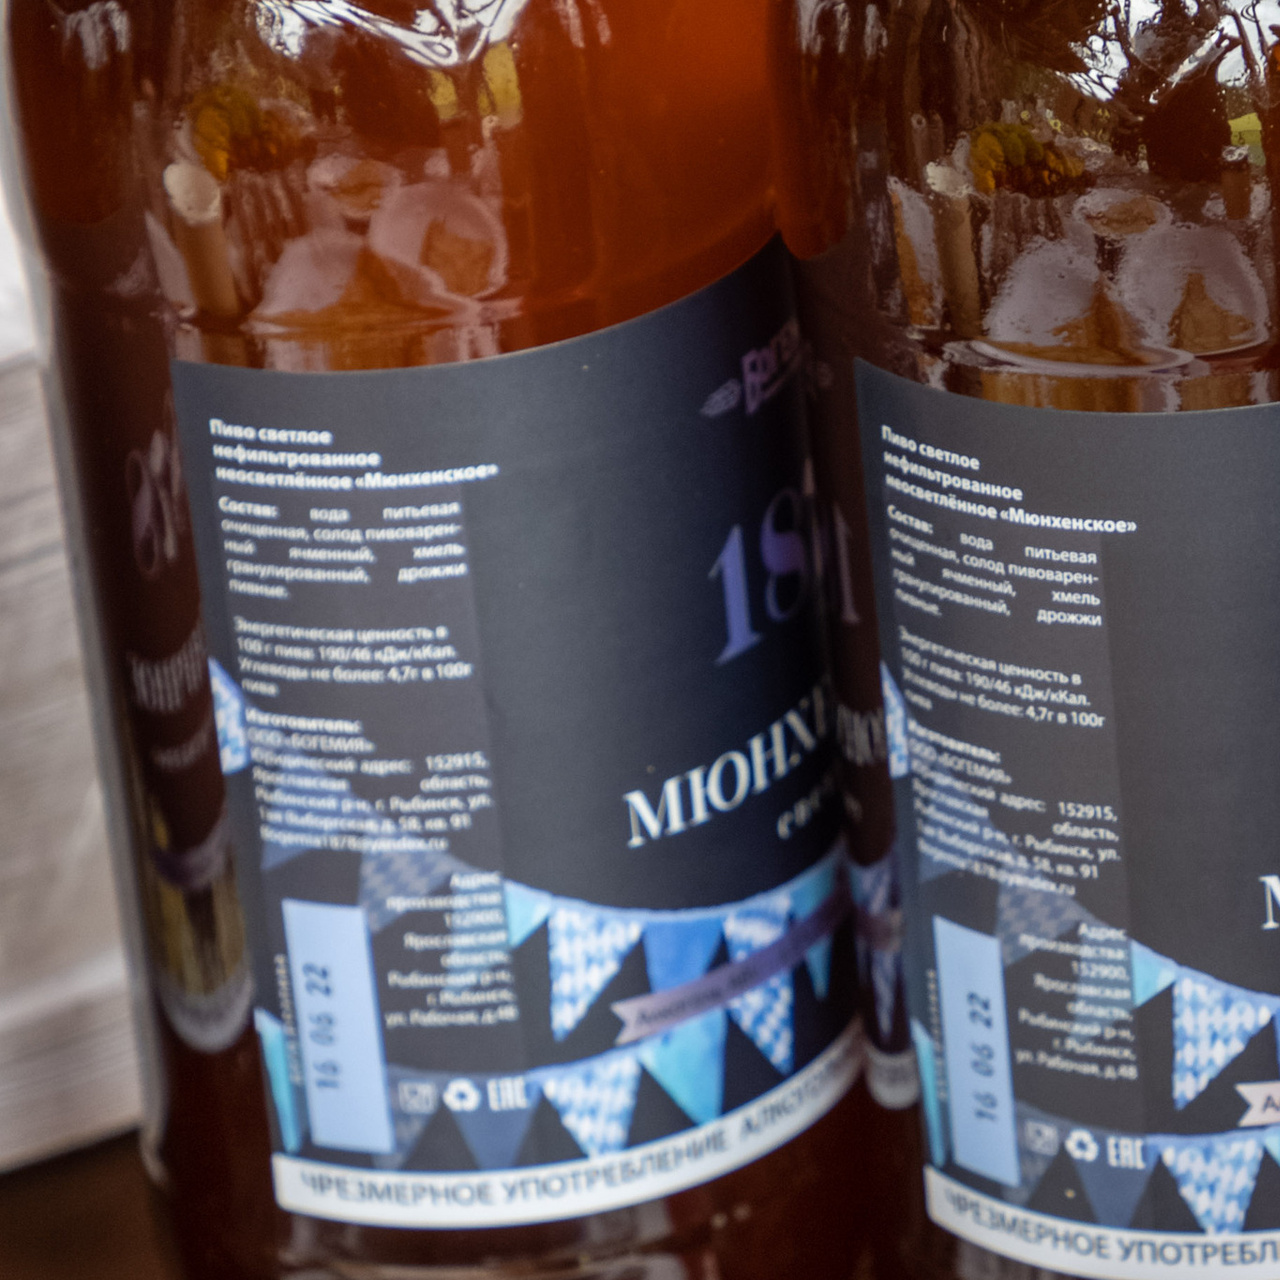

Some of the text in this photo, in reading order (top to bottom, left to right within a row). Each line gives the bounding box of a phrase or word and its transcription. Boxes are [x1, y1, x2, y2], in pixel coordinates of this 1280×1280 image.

[209, 418, 333, 446] Пиво светлое
[212, 443, 382, 469] нефильтрованное
[881, 424, 980, 470] Пиво светлое
[883, 450, 1023, 501] нефильтрованное
[218, 496, 461, 523] Состав: вода питьевая
[886, 473, 1137, 534] неосветлённое «Мюнхенское»
[313, 527, 363, 544] солод
[960, 532, 994, 551] вода
[1025, 545, 1098, 565] питьевая
[413, 543, 466, 559] хмель
[397, 561, 468, 583] дрожжи
[962, 552, 1005, 575] солод
[1008, 563, 1099, 586] пивоварен-
[1052, 590, 1101, 607] хмель
[1037, 608, 1102, 627] дрожжи
[998, 662, 1069, 685] ценность
[1071, 672, 1082, 686] в
[1057, 712, 1068, 724] в
[1071, 710, 1106, 728] 100г
[1058, 801, 1118, 822] 152915,
[1053, 822, 1120, 843] область,
[301, 962, 333, 997] 22
[966, 992, 998, 1122] 16 06 22
[946, 1188, 1112, 1261] ЧРЕЗМЕРНОЕ
